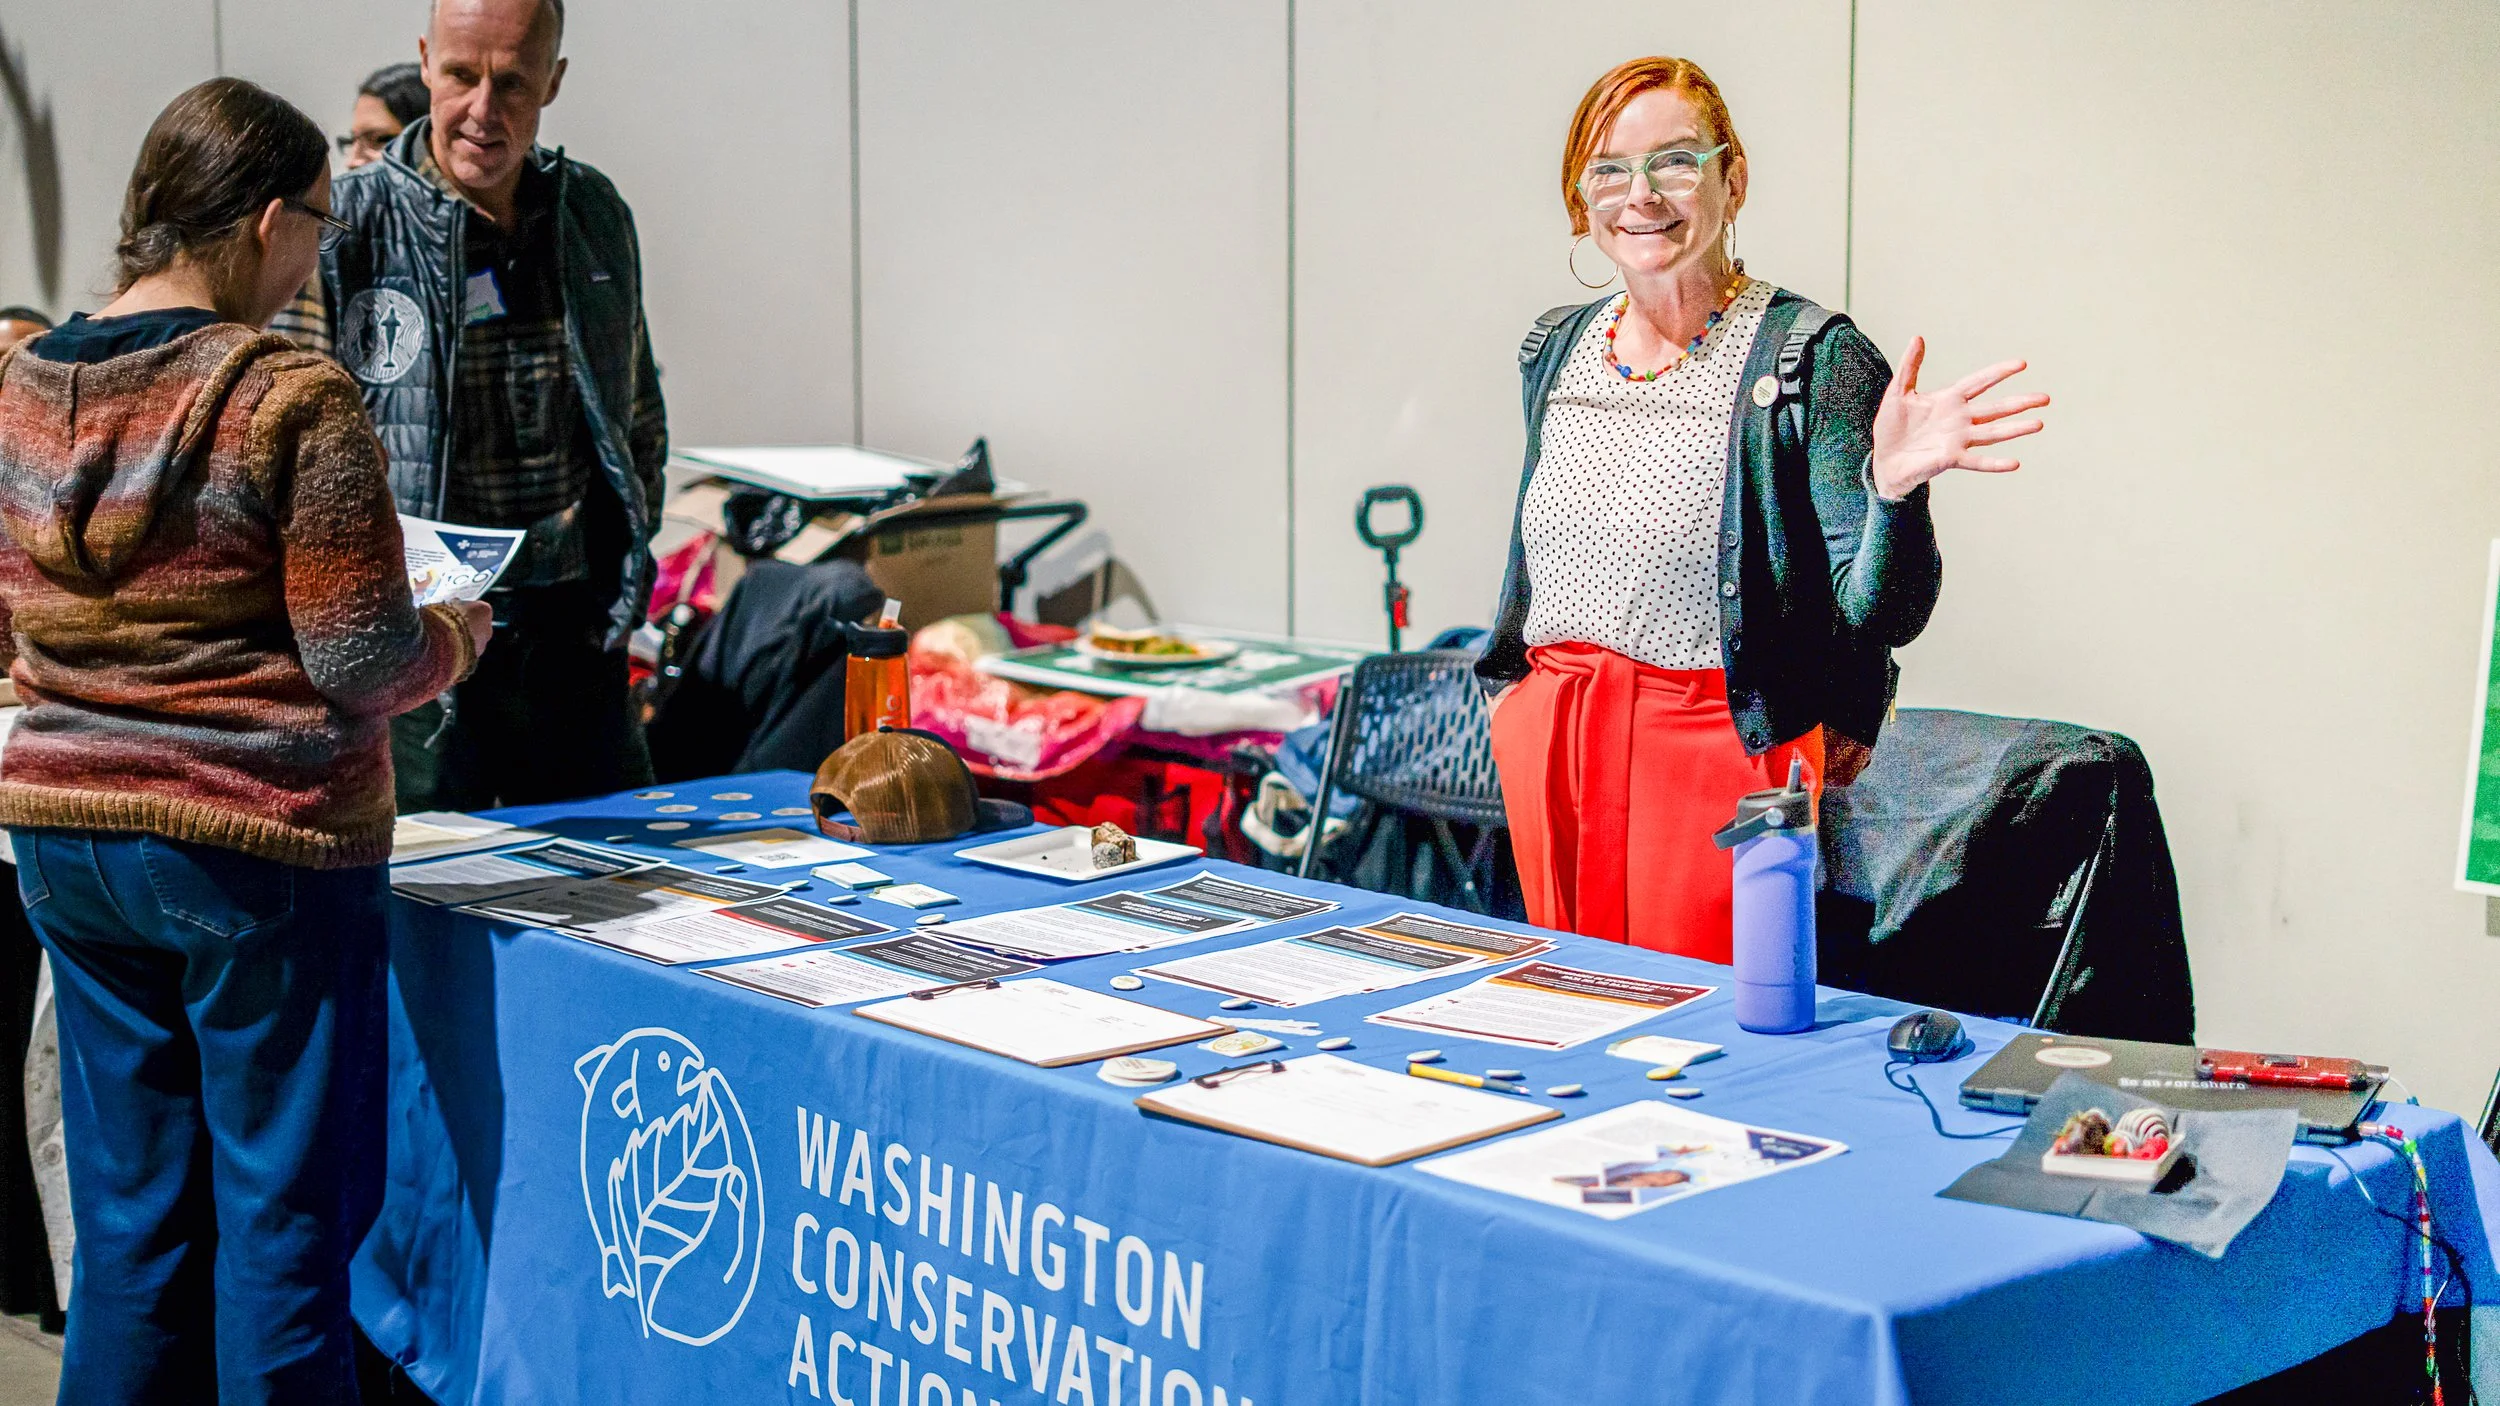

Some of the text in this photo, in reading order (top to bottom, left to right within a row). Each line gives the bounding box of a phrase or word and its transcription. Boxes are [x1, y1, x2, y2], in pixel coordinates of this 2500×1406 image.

[792, 1213, 1254, 1406] CONSERVATI
[797, 1106, 1204, 1350] WASHINGTON
[788, 1314, 1002, 1406] ACTI
